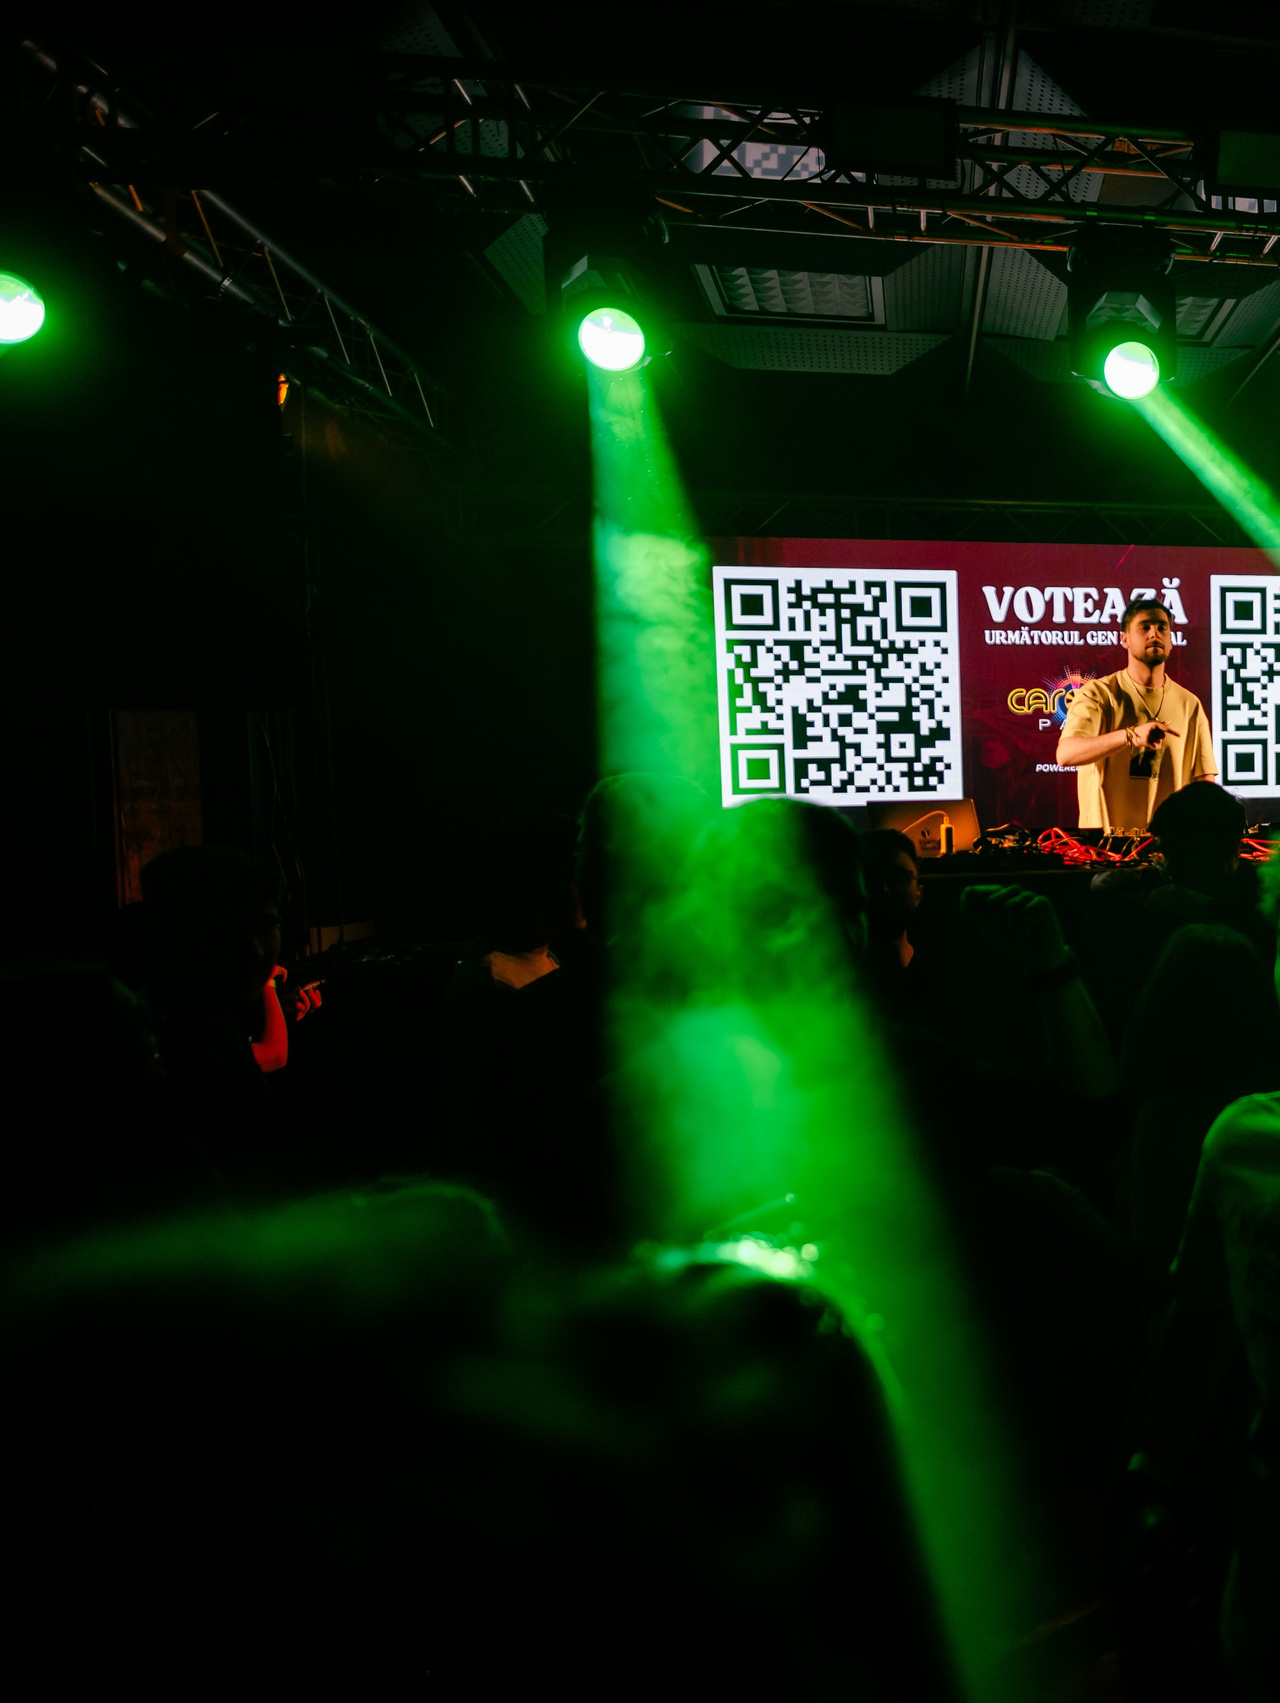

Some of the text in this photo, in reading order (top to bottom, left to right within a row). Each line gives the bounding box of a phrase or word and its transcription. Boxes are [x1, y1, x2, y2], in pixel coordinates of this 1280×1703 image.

[984, 626, 1085, 646] URMĂTORUL
[1086, 629, 1118, 646] GEN
[1035, 763, 1079, 773] POWERE
